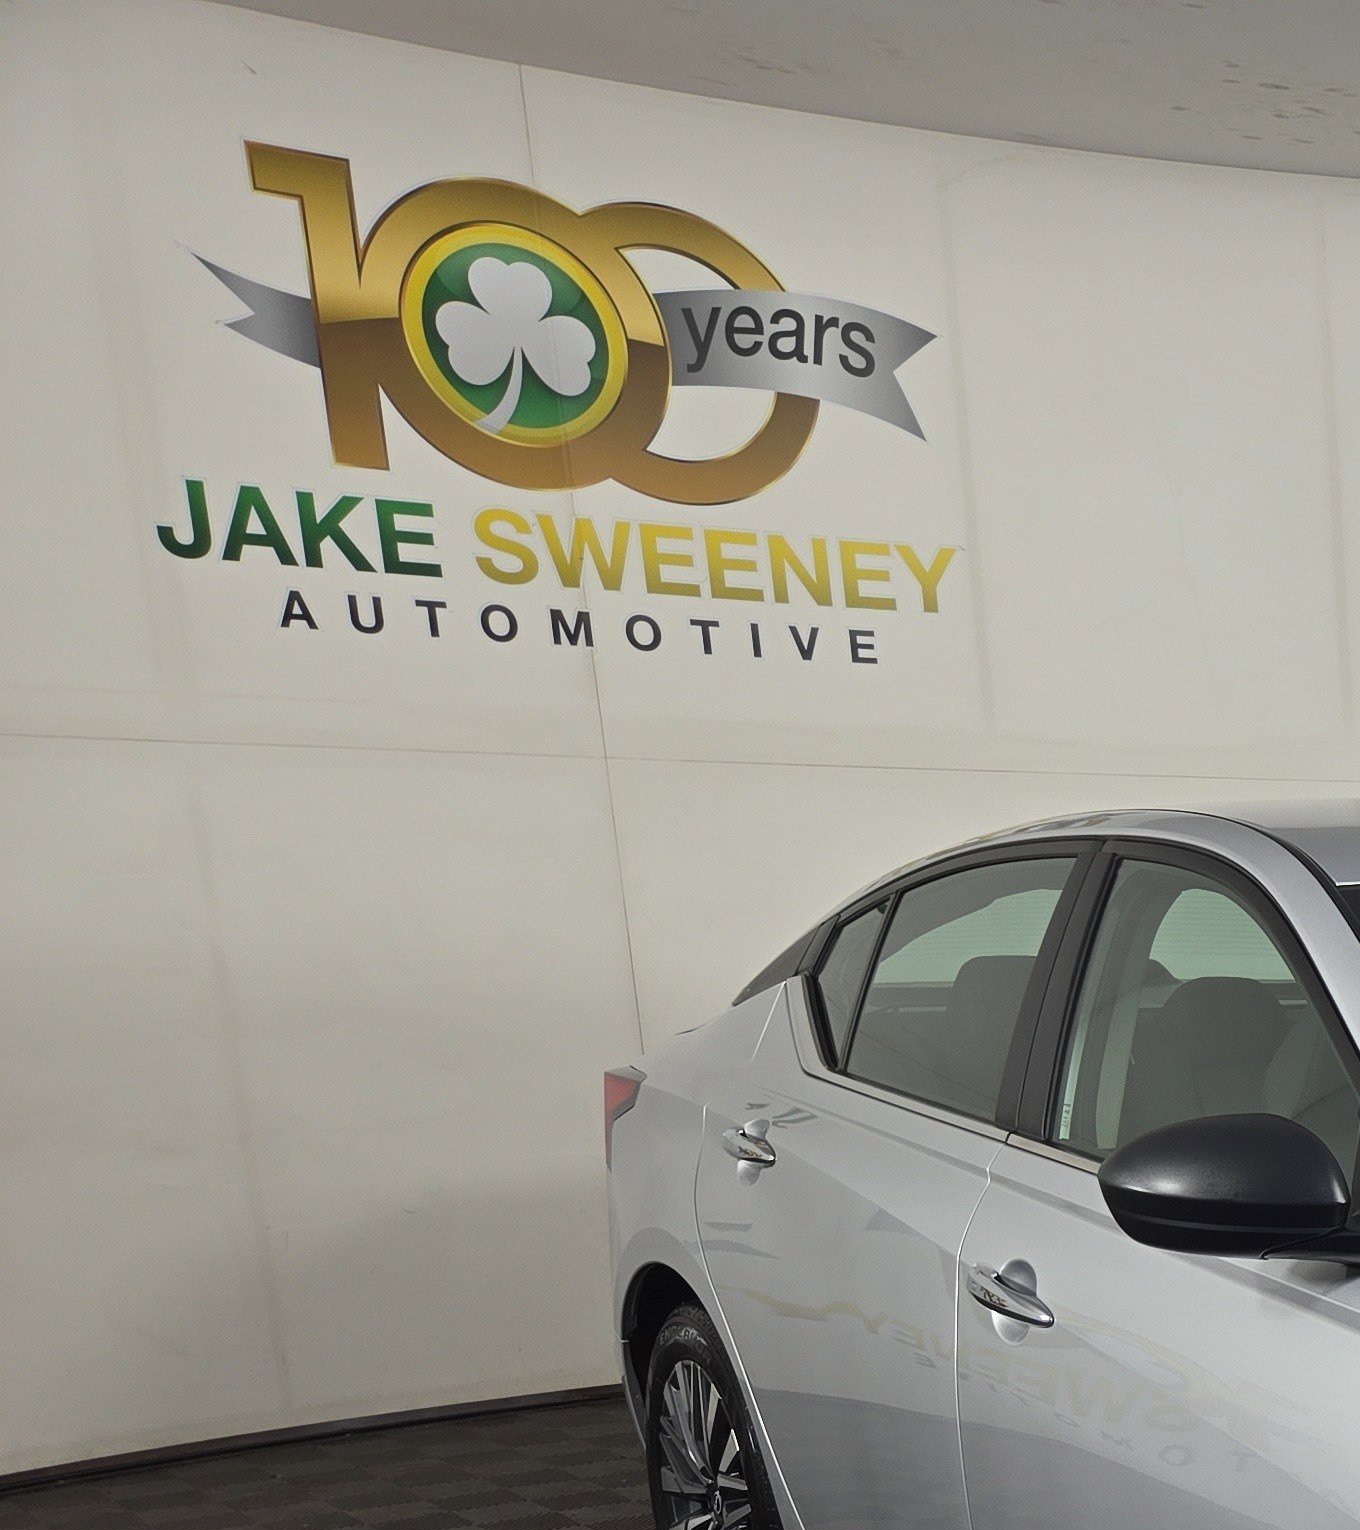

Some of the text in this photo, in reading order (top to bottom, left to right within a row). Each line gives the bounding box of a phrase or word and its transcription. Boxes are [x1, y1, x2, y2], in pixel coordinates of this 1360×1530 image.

[243, 139, 878, 505] 100 years
[156, 478, 957, 614] JAKE SWEENEY
[280, 589, 880, 665] AUTOMOTIVE
